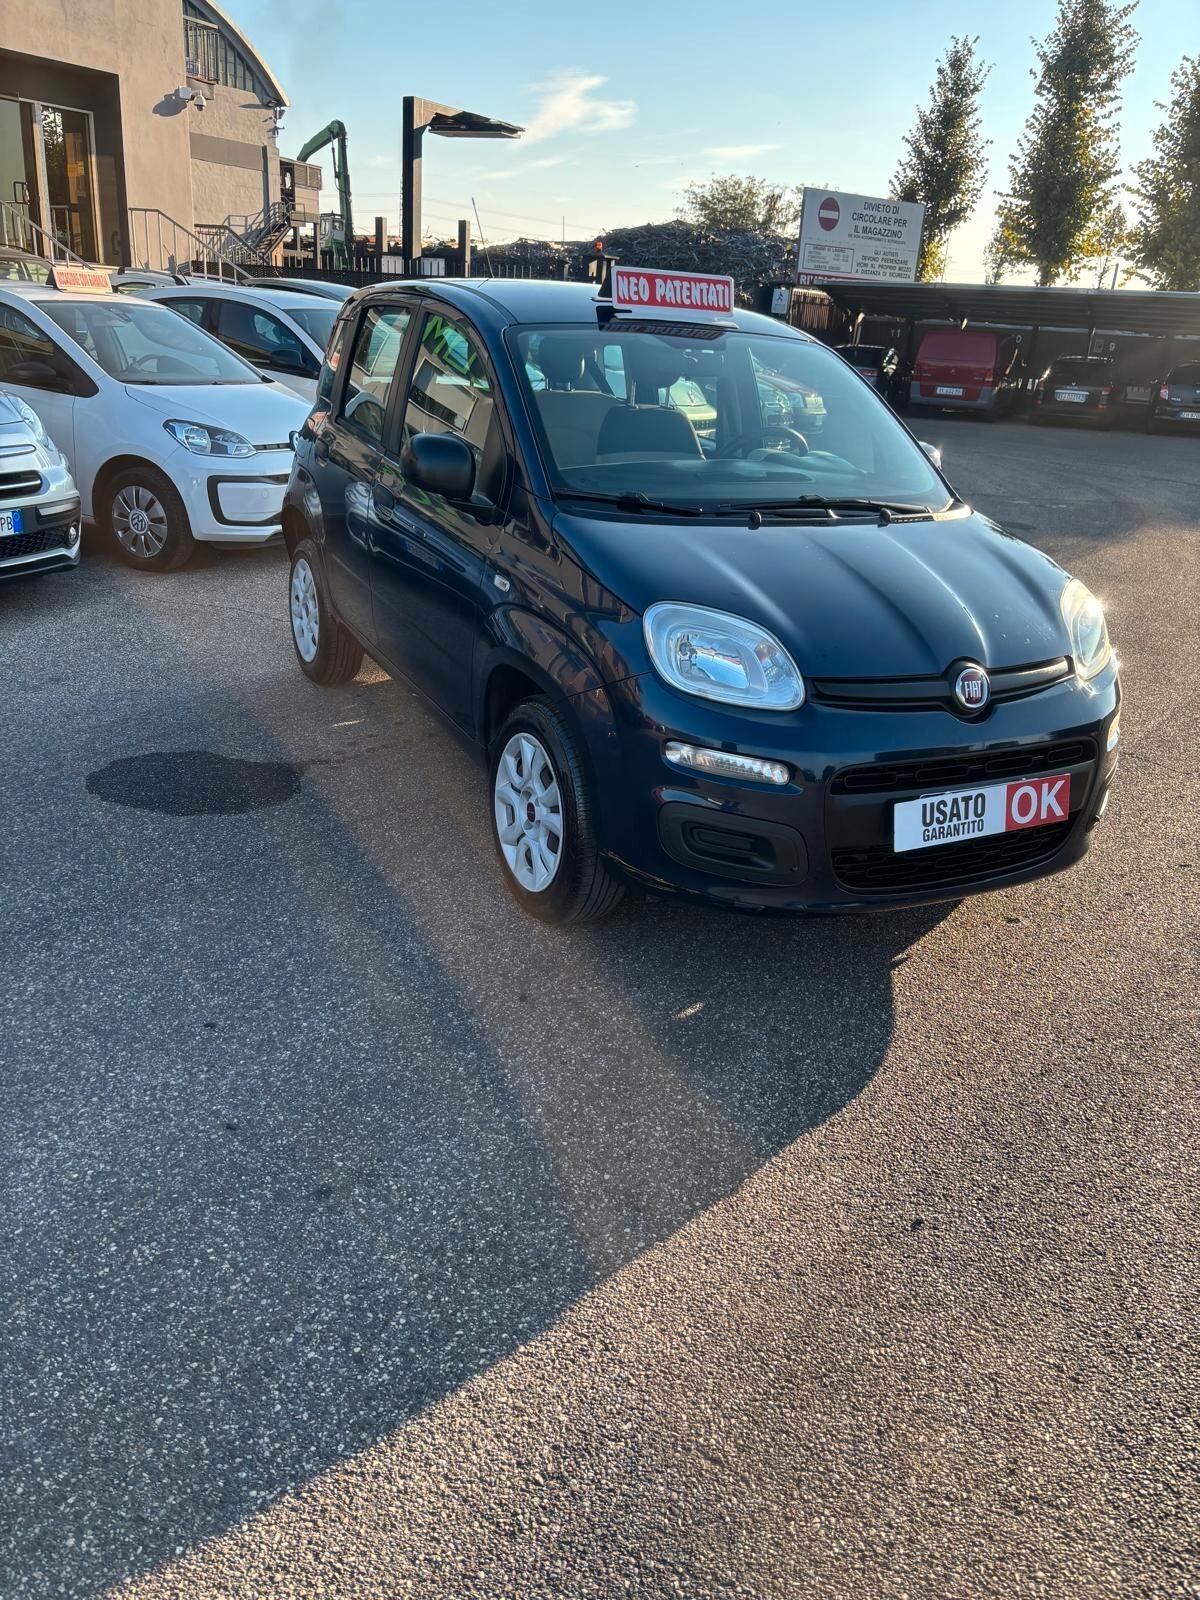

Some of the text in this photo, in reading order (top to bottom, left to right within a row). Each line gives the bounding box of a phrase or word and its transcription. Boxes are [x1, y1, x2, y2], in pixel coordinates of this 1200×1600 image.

[863, 201, 900, 215] DIVIETO DI
[851, 212, 908, 228] CIRCOLARE PER
[853, 224, 903, 239] IL MAGAZZINO
[617, 275, 729, 308] NEO PATENTATI
[964, 680, 982, 698] FIAT
[921, 793, 985, 827] USATO
[1011, 780, 1066, 825] OK
[922, 819, 985, 842] GARANTITO
